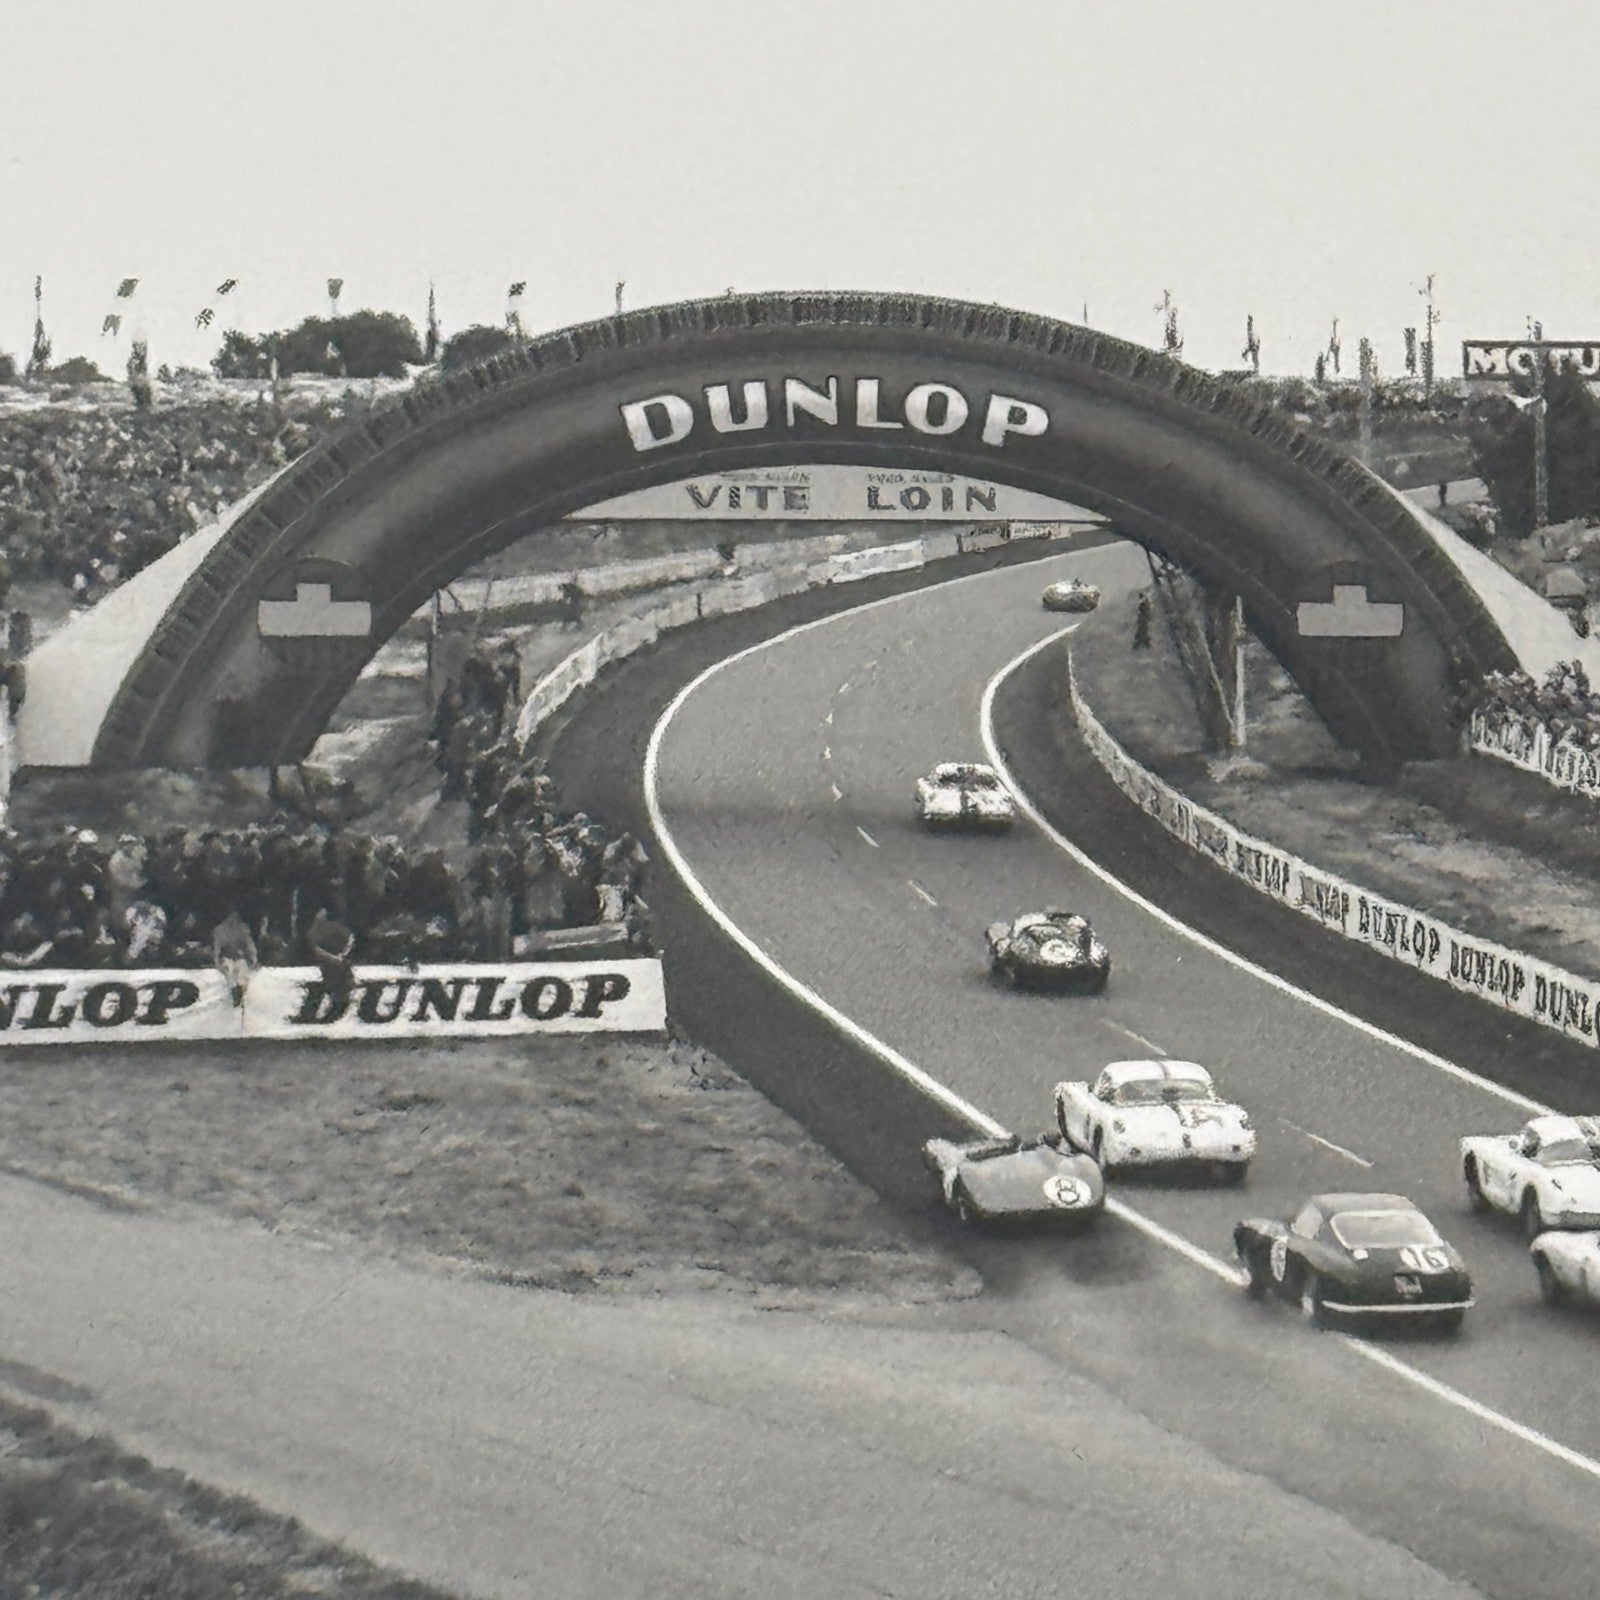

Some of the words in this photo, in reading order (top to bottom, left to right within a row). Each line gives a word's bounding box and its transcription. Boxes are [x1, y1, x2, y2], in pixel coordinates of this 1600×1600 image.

[622, 377, 1049, 452] DUNLOP
[686, 485, 811, 511] VITE
[867, 486, 998, 512] LOIN
[285, 973, 632, 1024] DUNLOP
